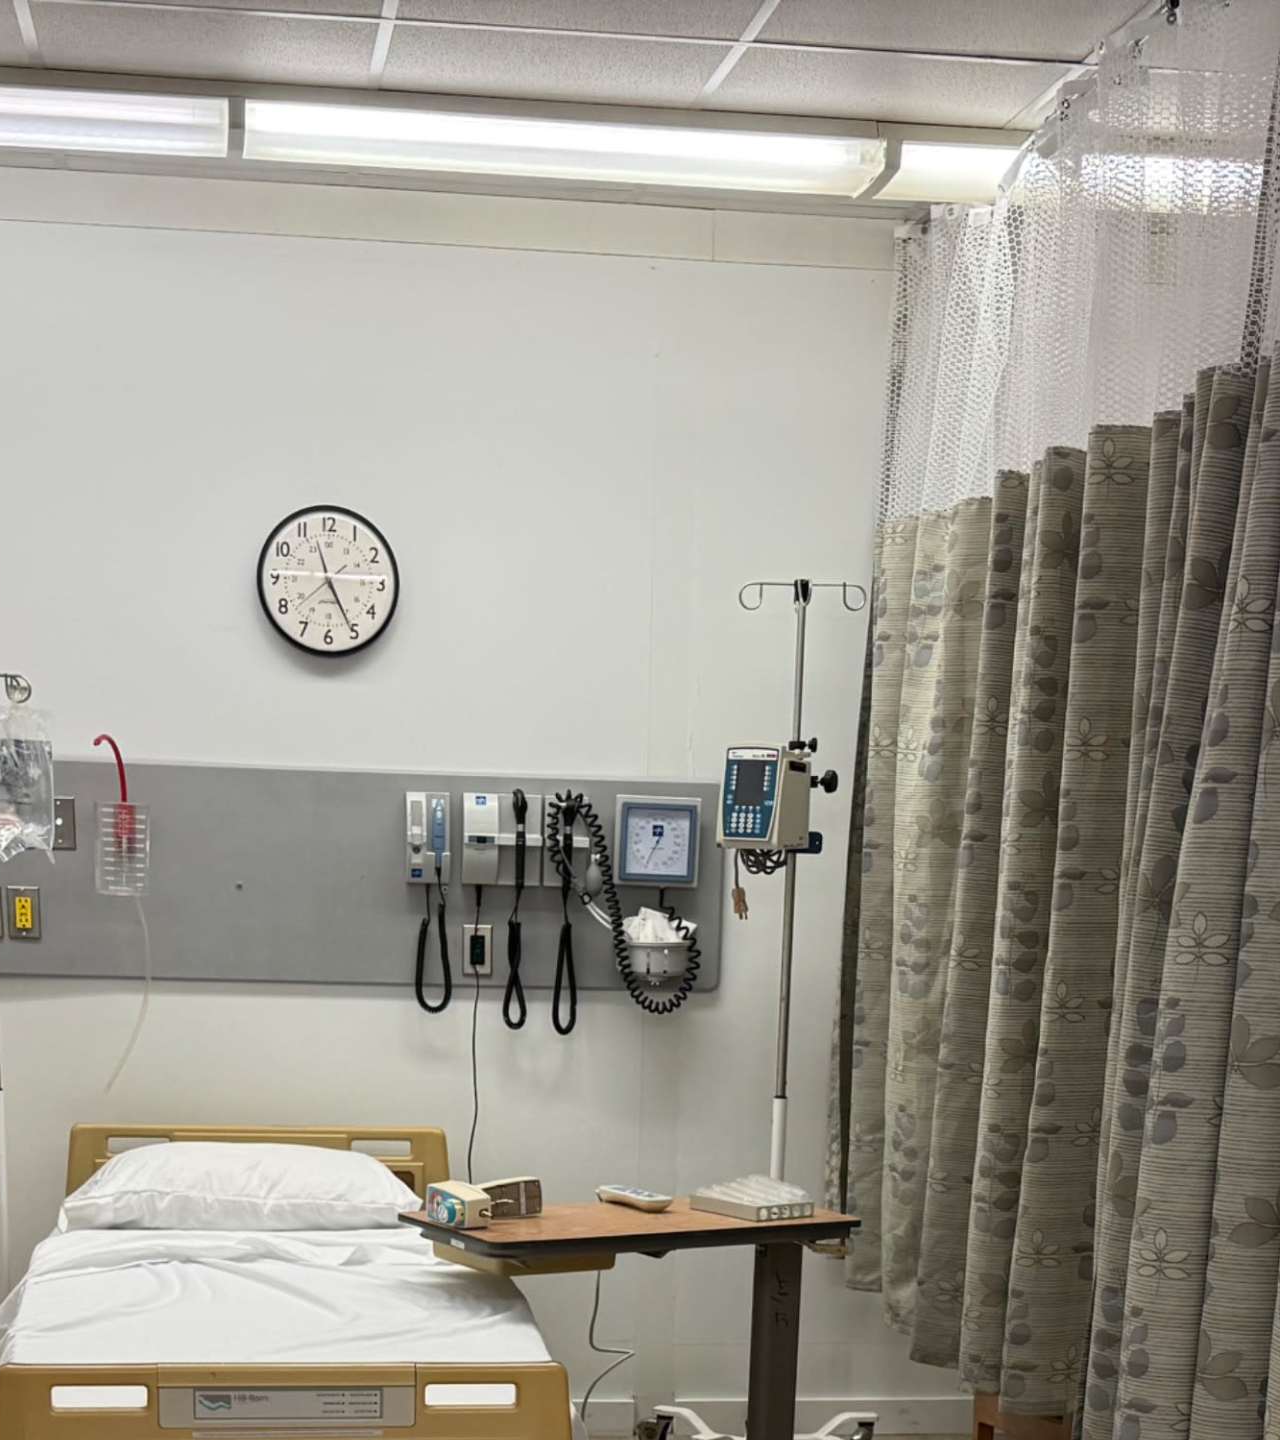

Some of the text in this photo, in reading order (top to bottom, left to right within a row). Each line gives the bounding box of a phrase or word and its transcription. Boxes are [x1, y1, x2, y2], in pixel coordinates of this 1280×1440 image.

[298, 522, 307, 538] 11
[322, 517, 337, 532] 12
[353, 525, 357, 542] 1
[276, 541, 290, 557] 10
[369, 547, 379, 563] 2
[270, 568, 280, 585] 9
[376, 578, 385, 592] 3
[278, 598, 288, 614] 8
[366, 604, 376, 620] 4
[299, 621, 309, 637] 7
[324, 629, 334, 645] 6
[349, 624, 359, 640] 5
